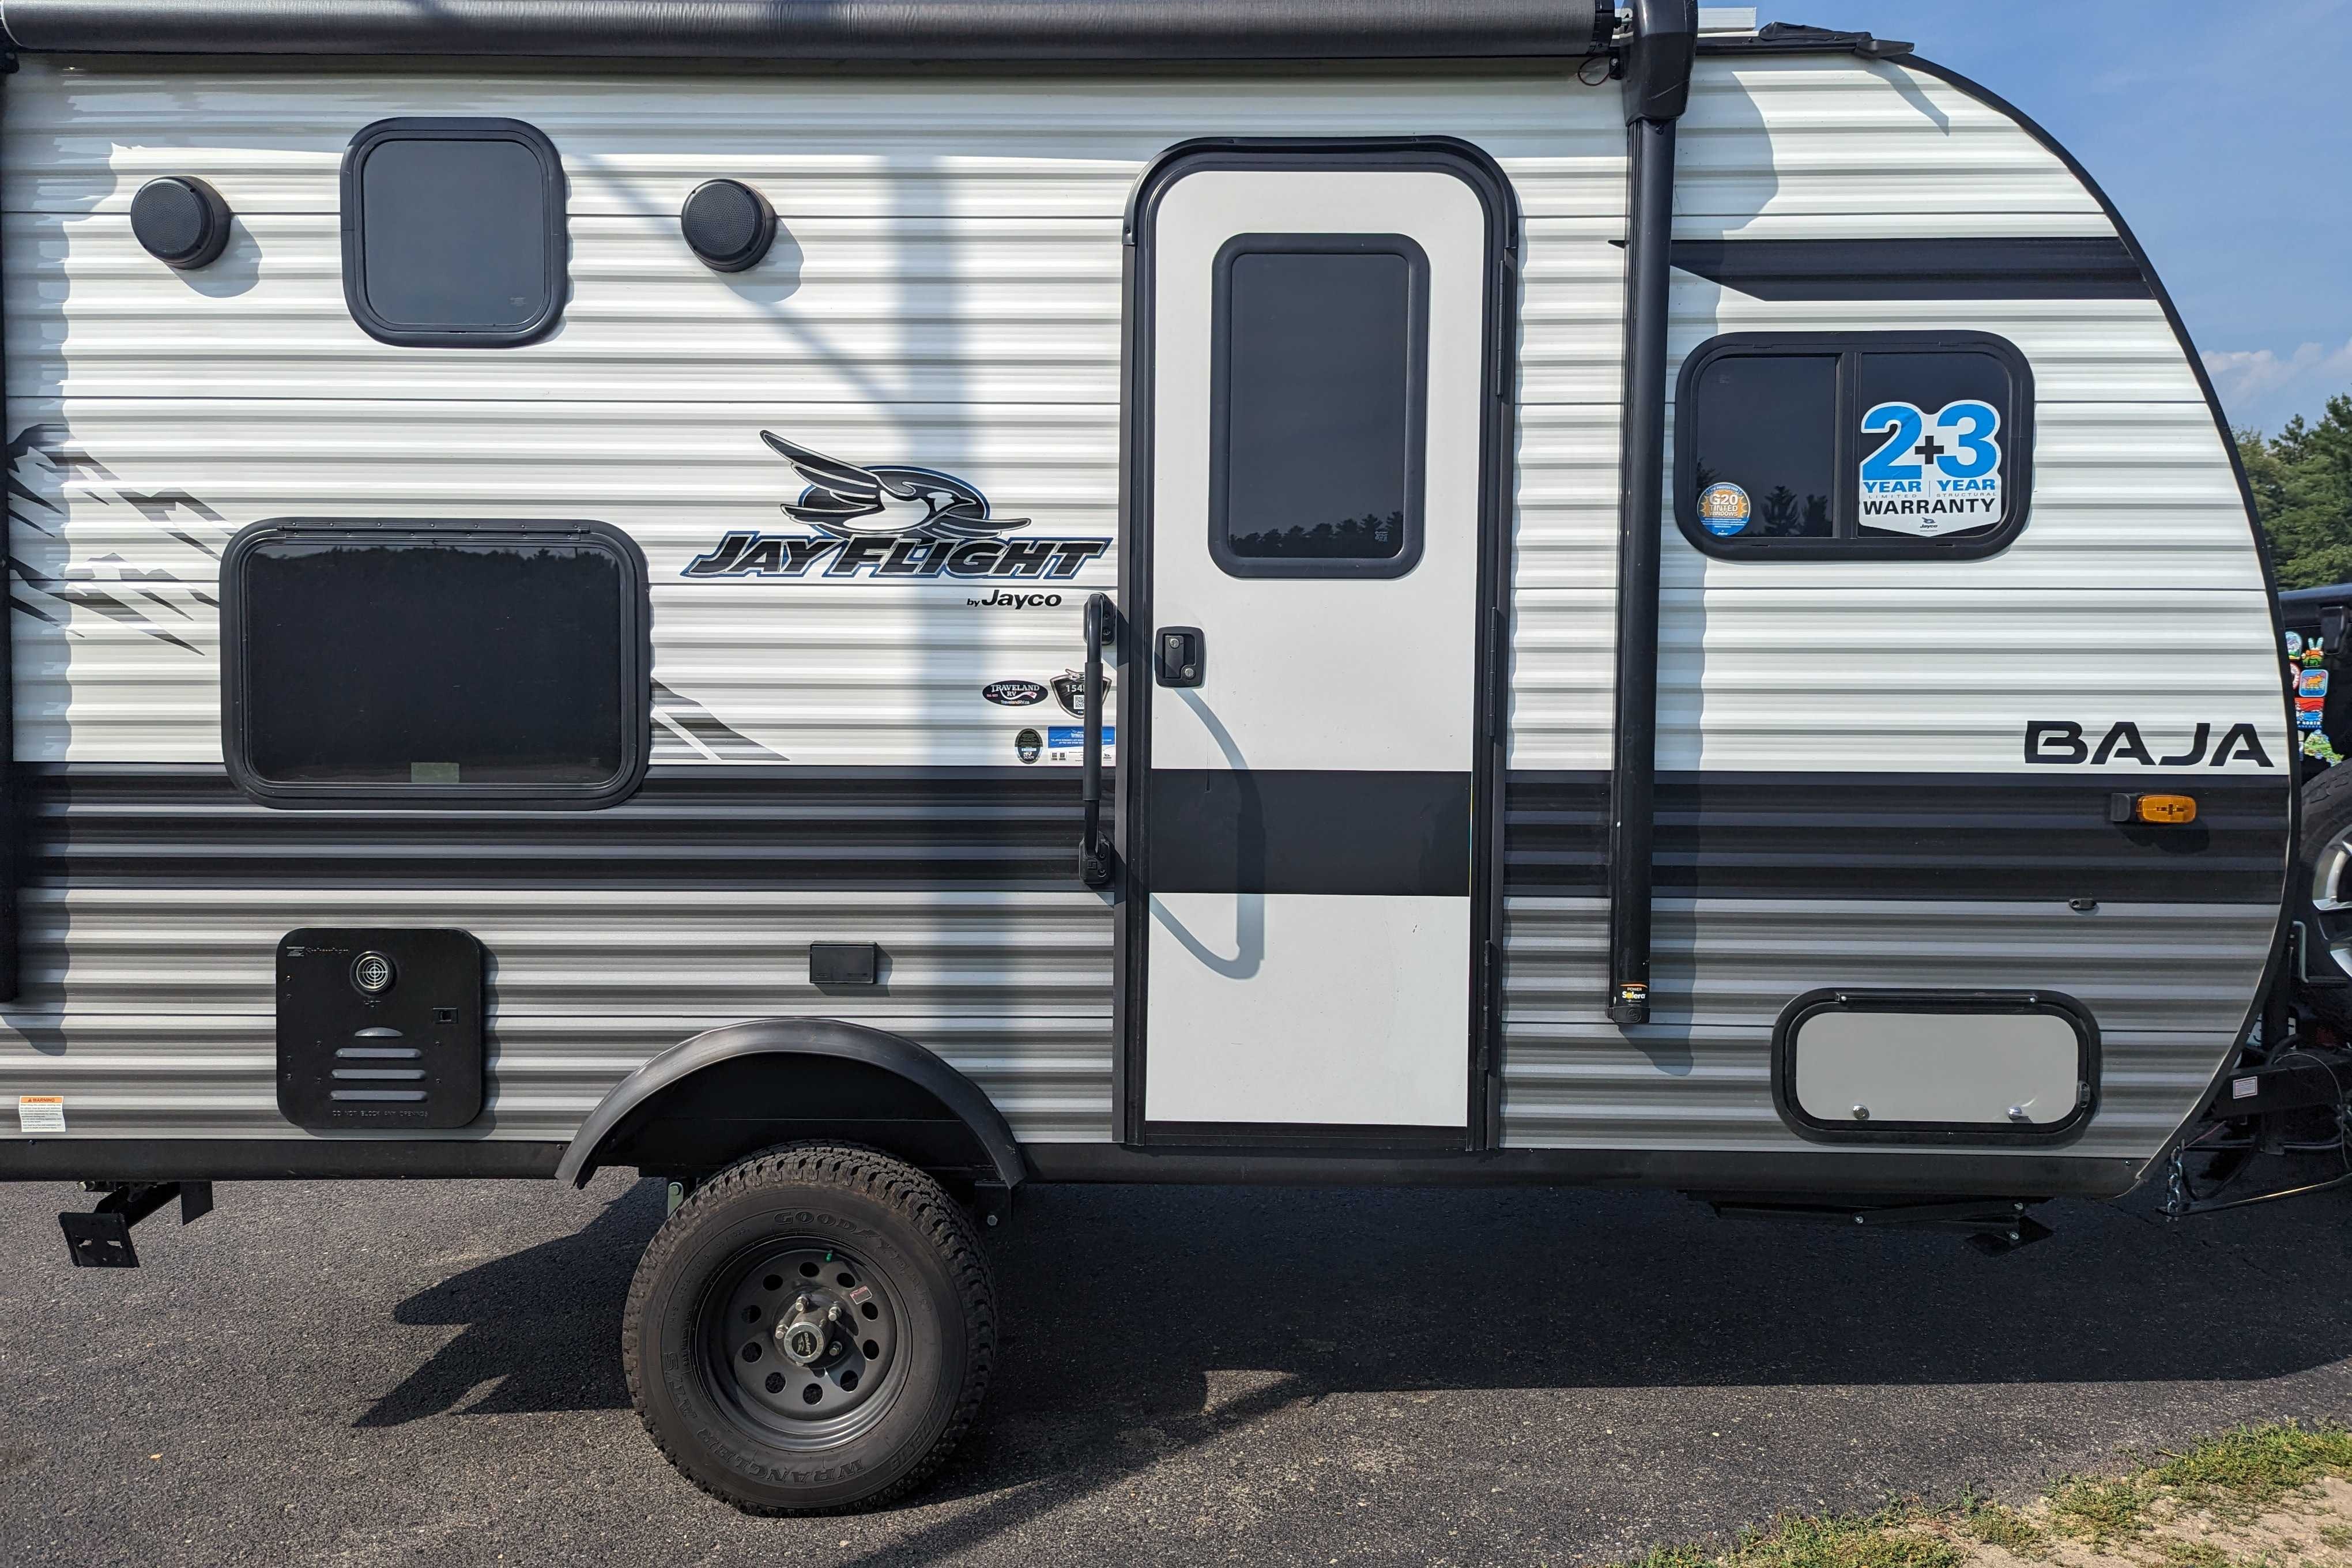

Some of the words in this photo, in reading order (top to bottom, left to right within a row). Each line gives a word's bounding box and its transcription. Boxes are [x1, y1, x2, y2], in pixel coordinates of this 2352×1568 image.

[1863, 481, 1921, 493] YEAR
[1937, 479, 1996, 491] YEAR
[1709, 493, 1739, 505] G20
[1863, 498, 1996, 515] WARRANTY
[680, 531, 847, 578] JAY
[822, 534, 1113, 579] FLIGHT
[967, 598, 980, 607] by
[981, 589, 1062, 610] Jayco
[990, 684, 1040, 692] TRAVELAND
[1066, 684, 1084, 692] 154
[2024, 720, 2274, 767] BAJA
[1622, 991, 1646, 999] Solera
[774, 1211, 933, 1312] GOODYEAR
[697, 1427, 865, 1485] WRANGLER
